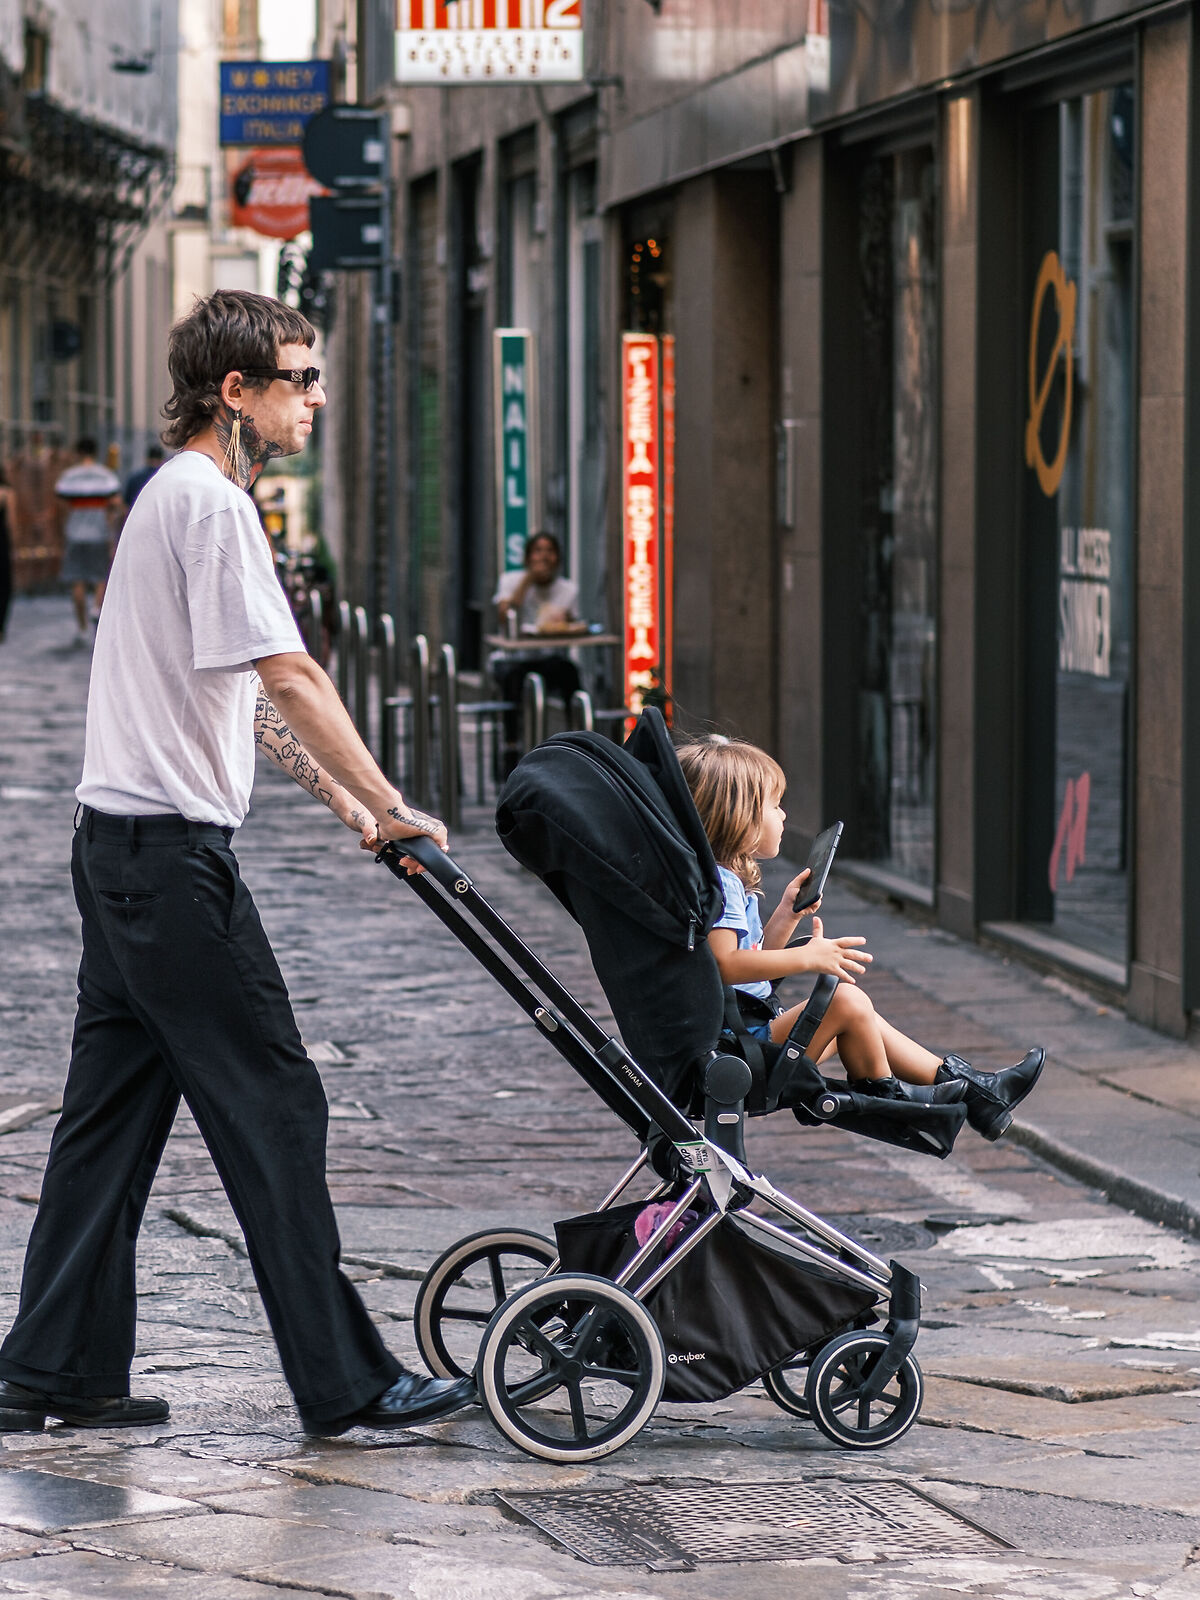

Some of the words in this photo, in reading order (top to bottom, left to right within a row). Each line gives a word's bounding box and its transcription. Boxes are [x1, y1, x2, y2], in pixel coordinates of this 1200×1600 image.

[628, 347, 653, 473] PIZZERIA
[504, 363, 525, 566] NAILS
[622, 1065, 642, 1087] PRIAM
[678, 1352, 705, 1364] cybex
